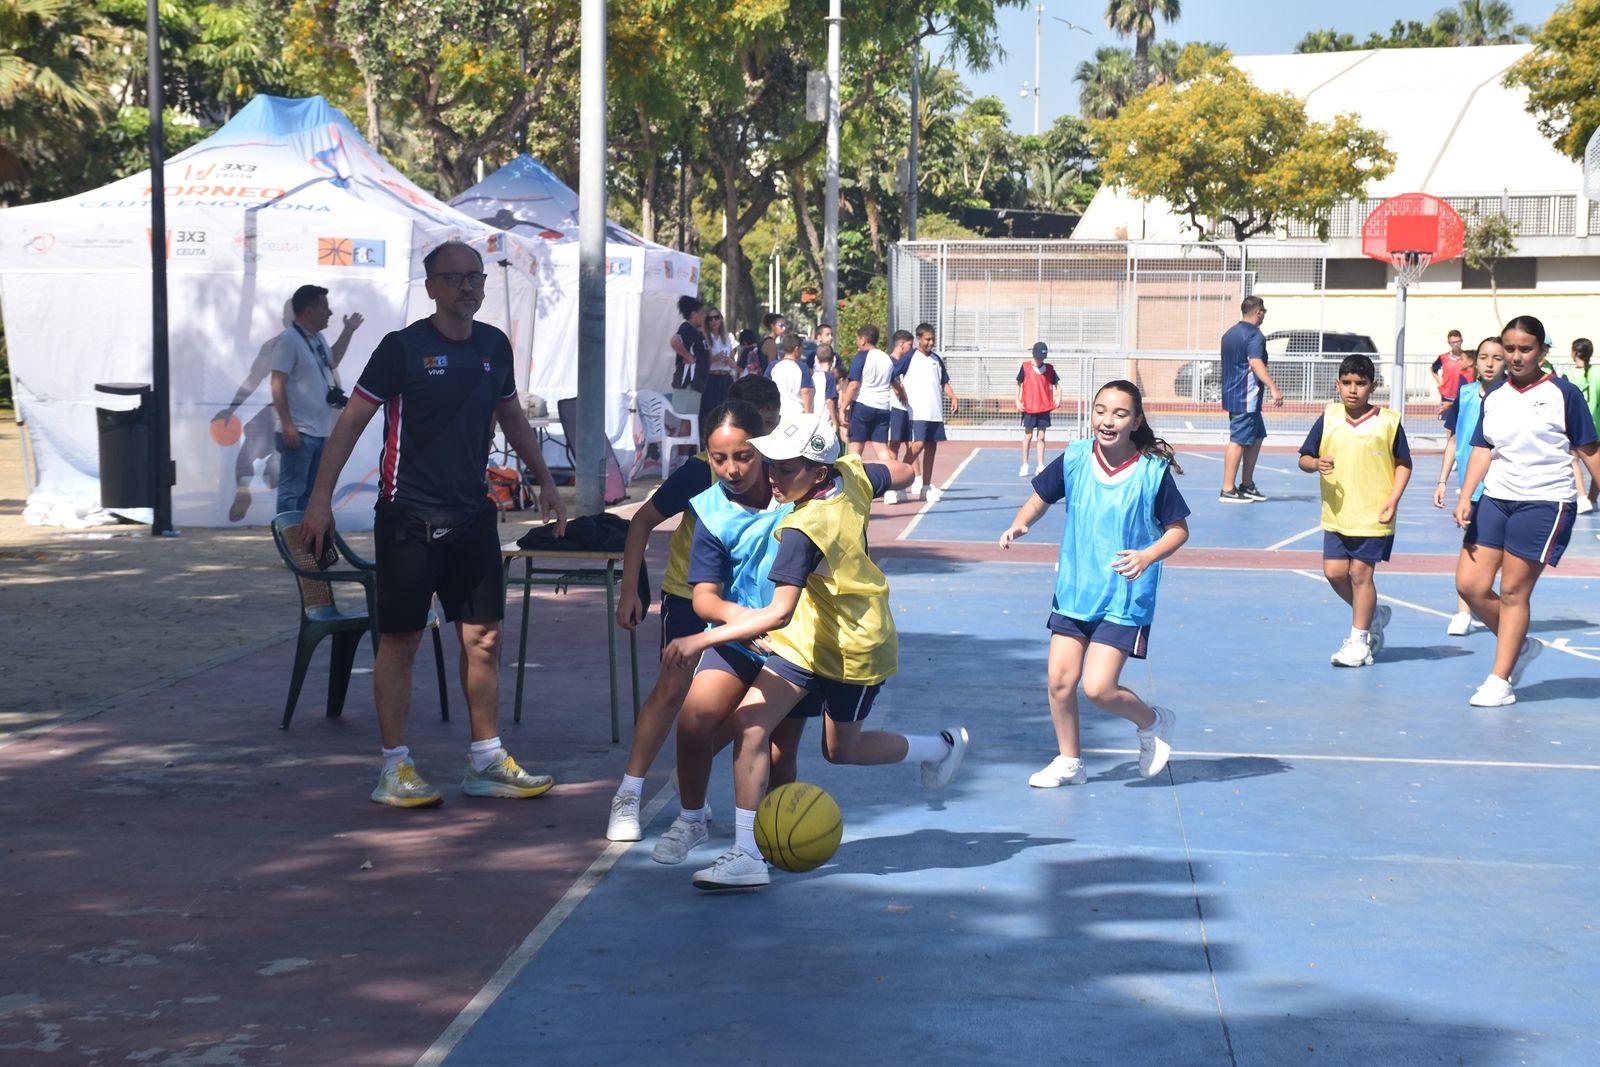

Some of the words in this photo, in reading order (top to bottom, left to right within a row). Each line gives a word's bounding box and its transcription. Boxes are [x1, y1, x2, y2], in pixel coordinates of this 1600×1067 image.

[140, 186, 287, 199] TORNEO
[79, 200, 164, 208] CEUT
[176, 231, 206, 243] 3X3
[176, 248, 206, 256] CEUTA
